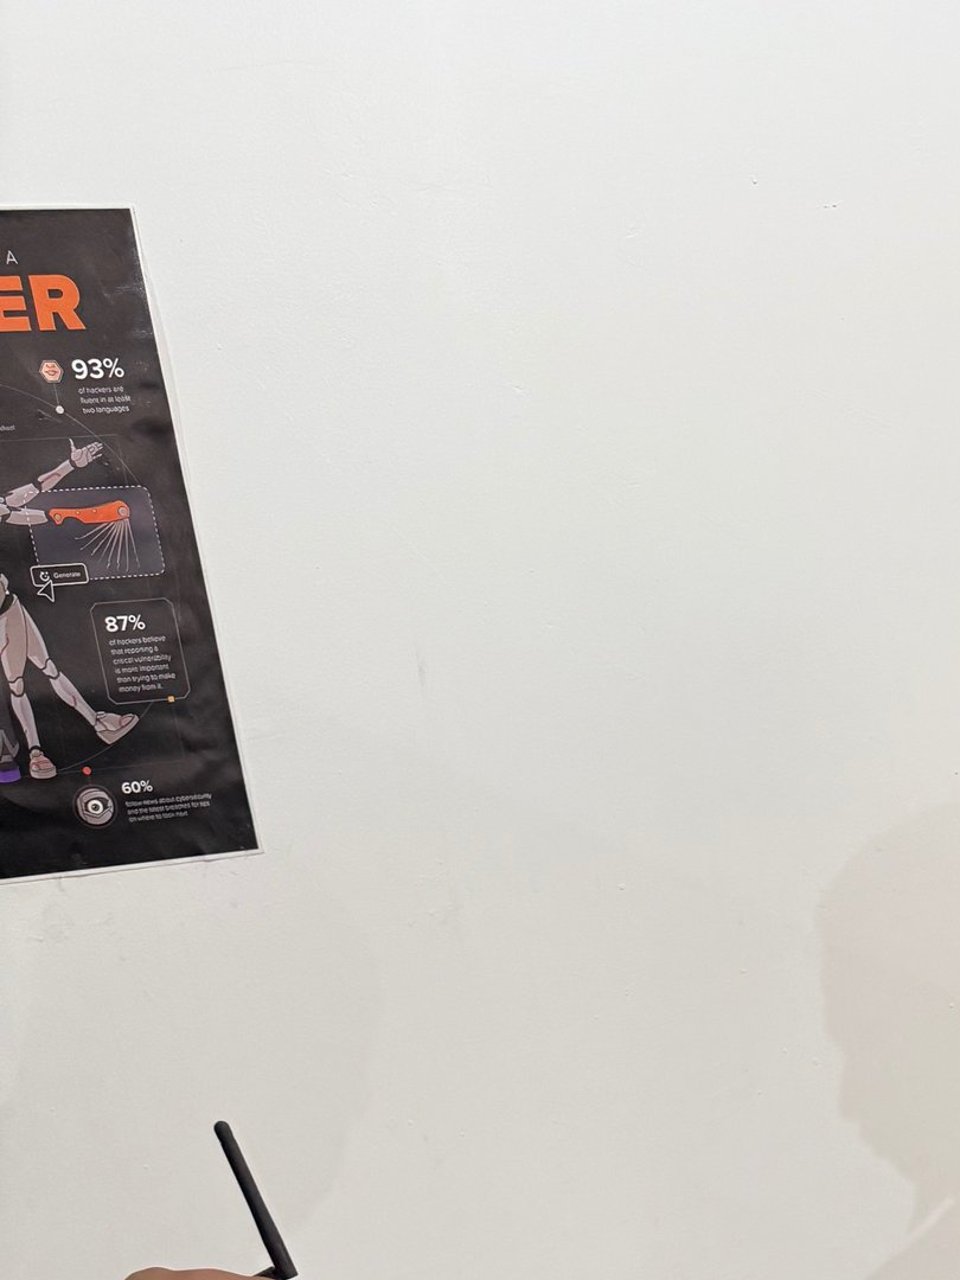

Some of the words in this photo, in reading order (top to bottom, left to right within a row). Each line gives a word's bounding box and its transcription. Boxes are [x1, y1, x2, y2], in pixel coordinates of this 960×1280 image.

[6, 250, 19, 265] A
[71, 358, 125, 379] 93%
[104, 614, 146, 632] 87%
[121, 780, 153, 794] 60%
